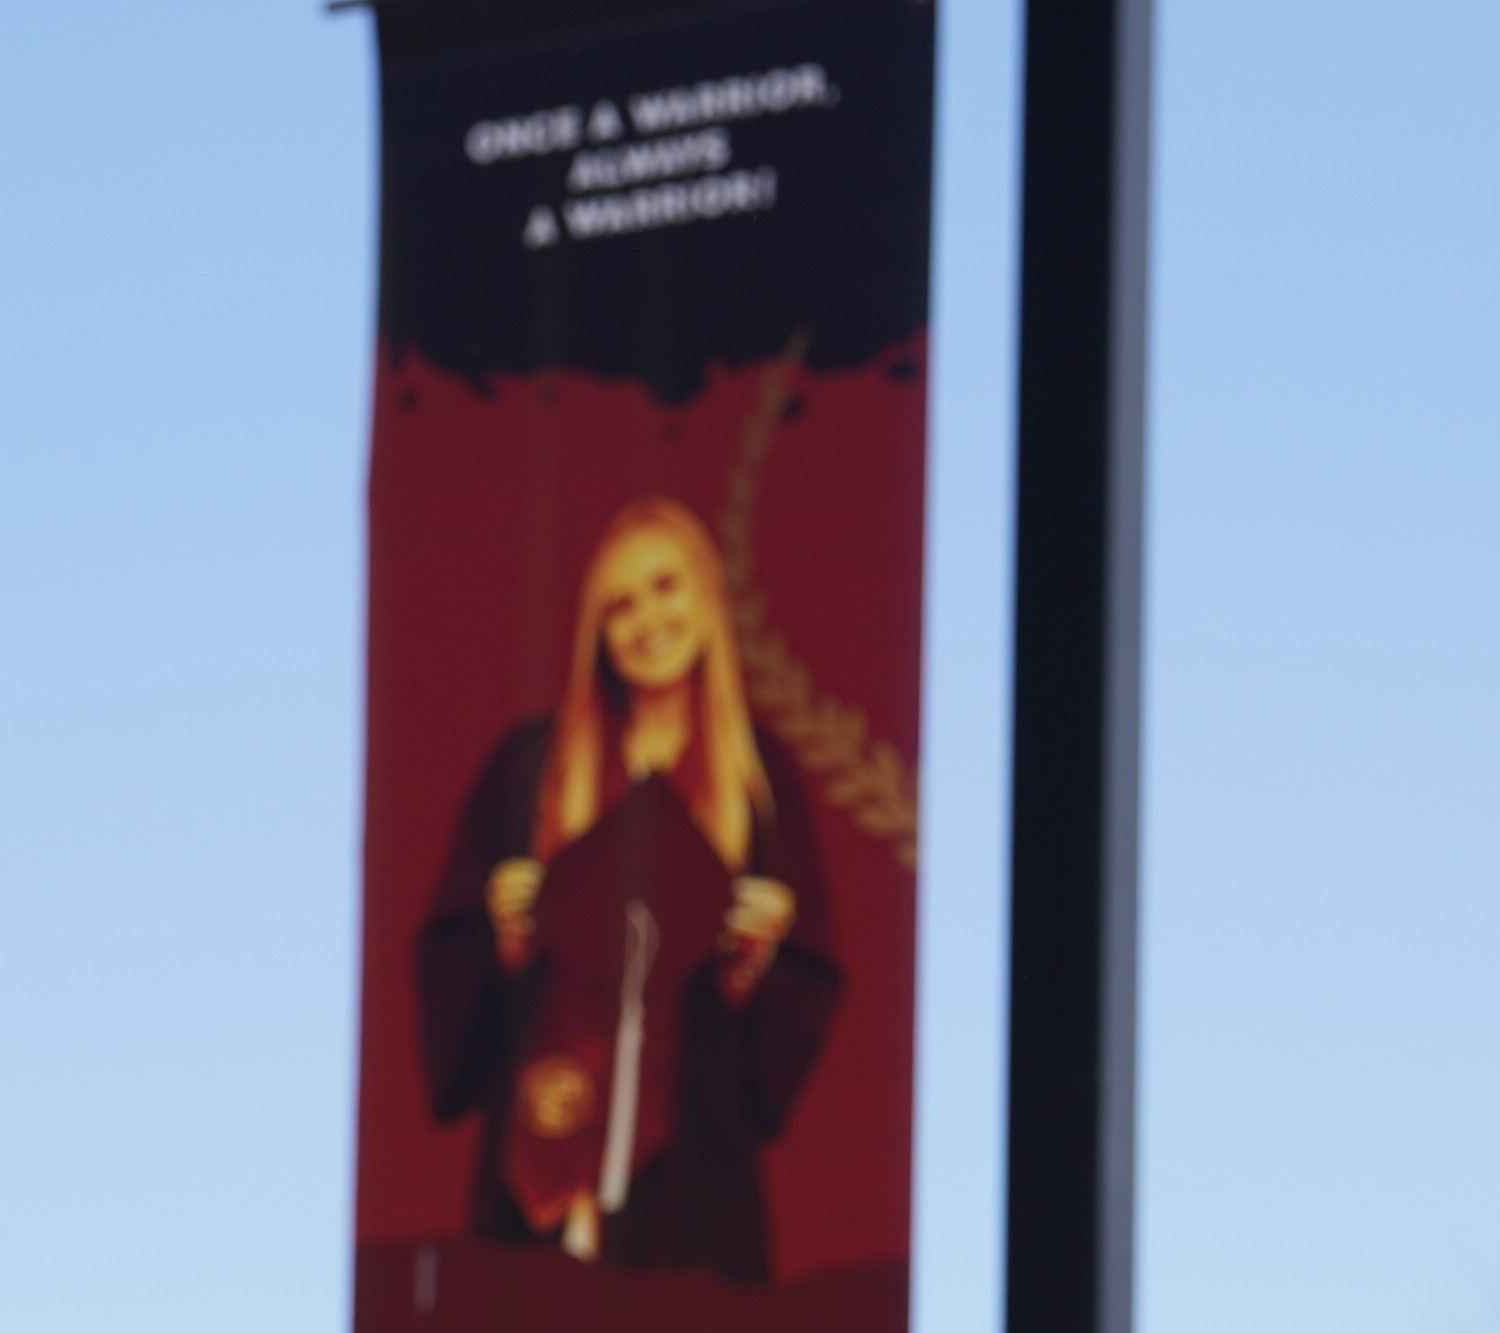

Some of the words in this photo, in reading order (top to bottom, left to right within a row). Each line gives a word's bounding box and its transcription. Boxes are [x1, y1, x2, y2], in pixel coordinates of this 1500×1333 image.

[464, 104, 584, 166] ONCE
[586, 98, 624, 143] A
[566, 125, 732, 194] ALWAYS
[522, 203, 562, 250] A
